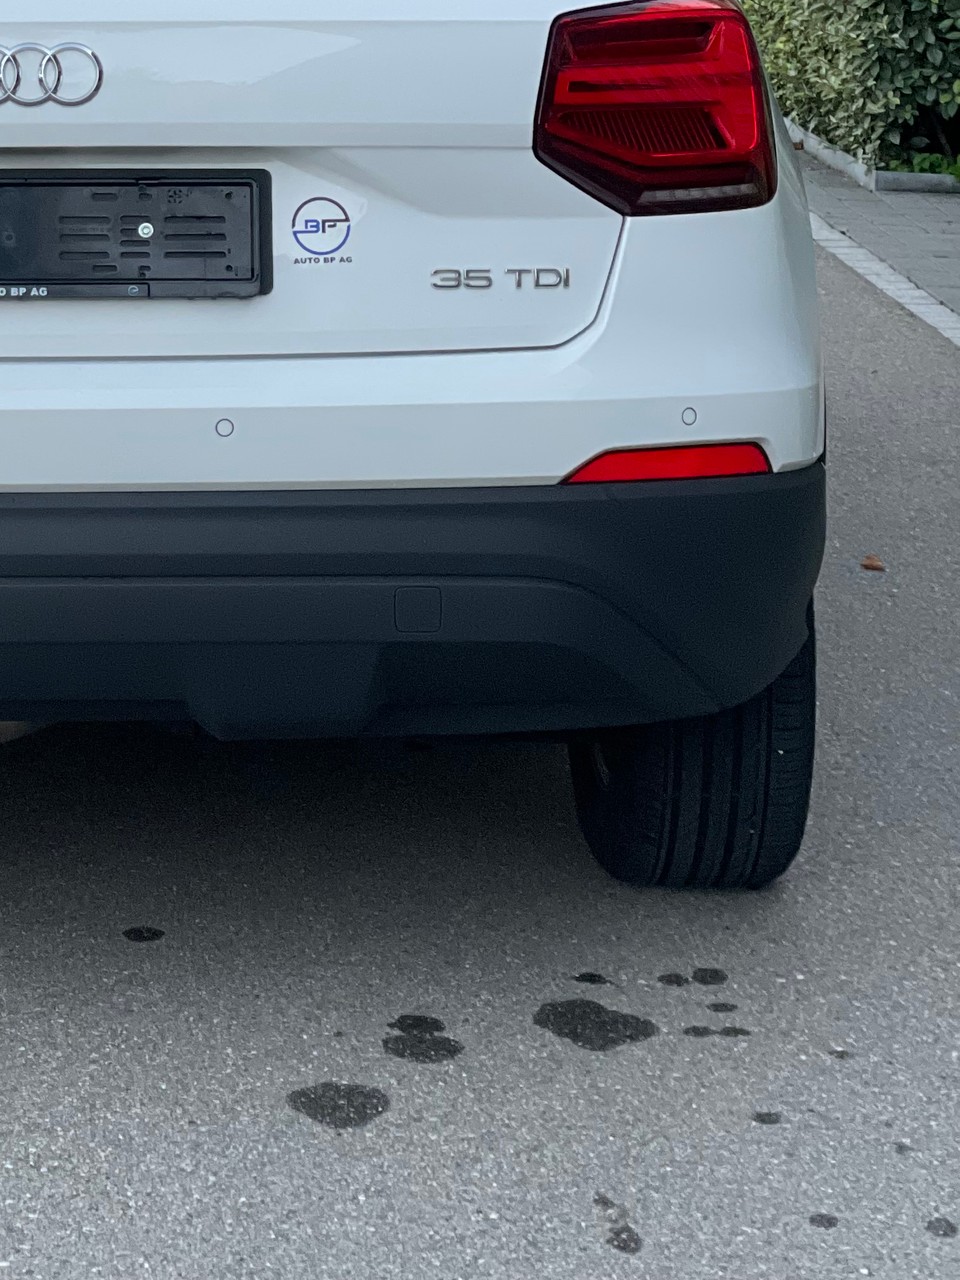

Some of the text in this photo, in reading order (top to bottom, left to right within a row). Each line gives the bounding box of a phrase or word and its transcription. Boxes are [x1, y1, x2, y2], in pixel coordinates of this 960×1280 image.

[293, 256, 353, 265] AUTO BP AG
[431, 268, 570, 290] 35 TDI
[10, 287, 27, 297] BP
[30, 287, 48, 297] AG
